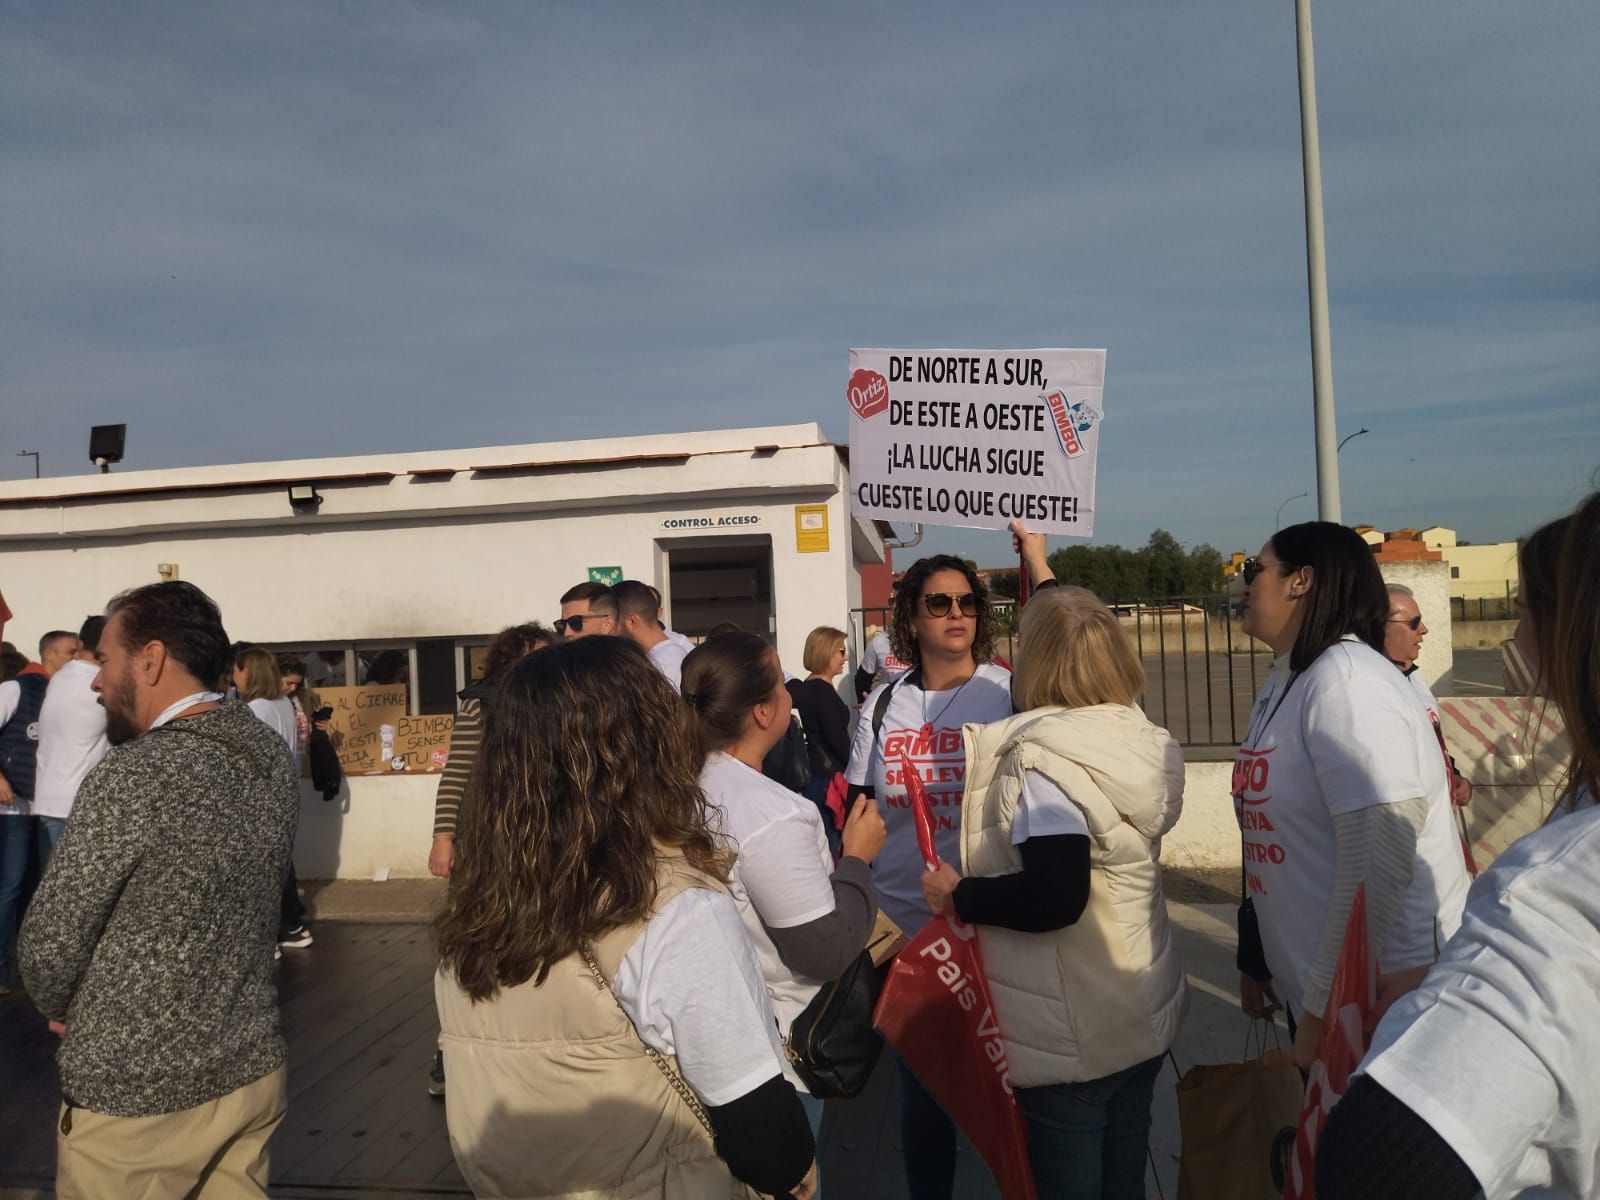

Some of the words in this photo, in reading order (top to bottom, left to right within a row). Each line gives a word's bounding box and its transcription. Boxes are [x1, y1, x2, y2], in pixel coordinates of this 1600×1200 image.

[890, 356, 913, 383] DE
[917, 357, 980, 384] NORTE
[985, 358, 998, 385] A
[1003, 358, 1048, 390] SUR,
[851, 377, 887, 410] Ortiz
[890, 400, 913, 426] DE
[918, 401, 960, 428] ESTE
[965, 402, 978, 429] A
[983, 403, 1045, 432] OESTE
[1048, 392, 1079, 455] BIMBO
[888, 443, 915, 474] ¡LA
[920, 445, 981, 473] LUCHA
[987, 448, 1044, 476] SIGUE
[858, 482, 923, 510] CUESTE
[928, 487, 950, 513] LO
[955, 489, 994, 518] QUE
[999, 492, 1078, 522] CUESTE!
[663, 518, 714, 529] CONTROL
[718, 515, 759, 526] ACCESO
[356, 691, 405, 709] CIERRE
[398, 717, 453, 737] BIMBO
[407, 734, 446, 750] SENSE
[402, 751, 429, 766] TU
[884, 732, 966, 757] BIMB
[919, 936, 977, 1011] País
